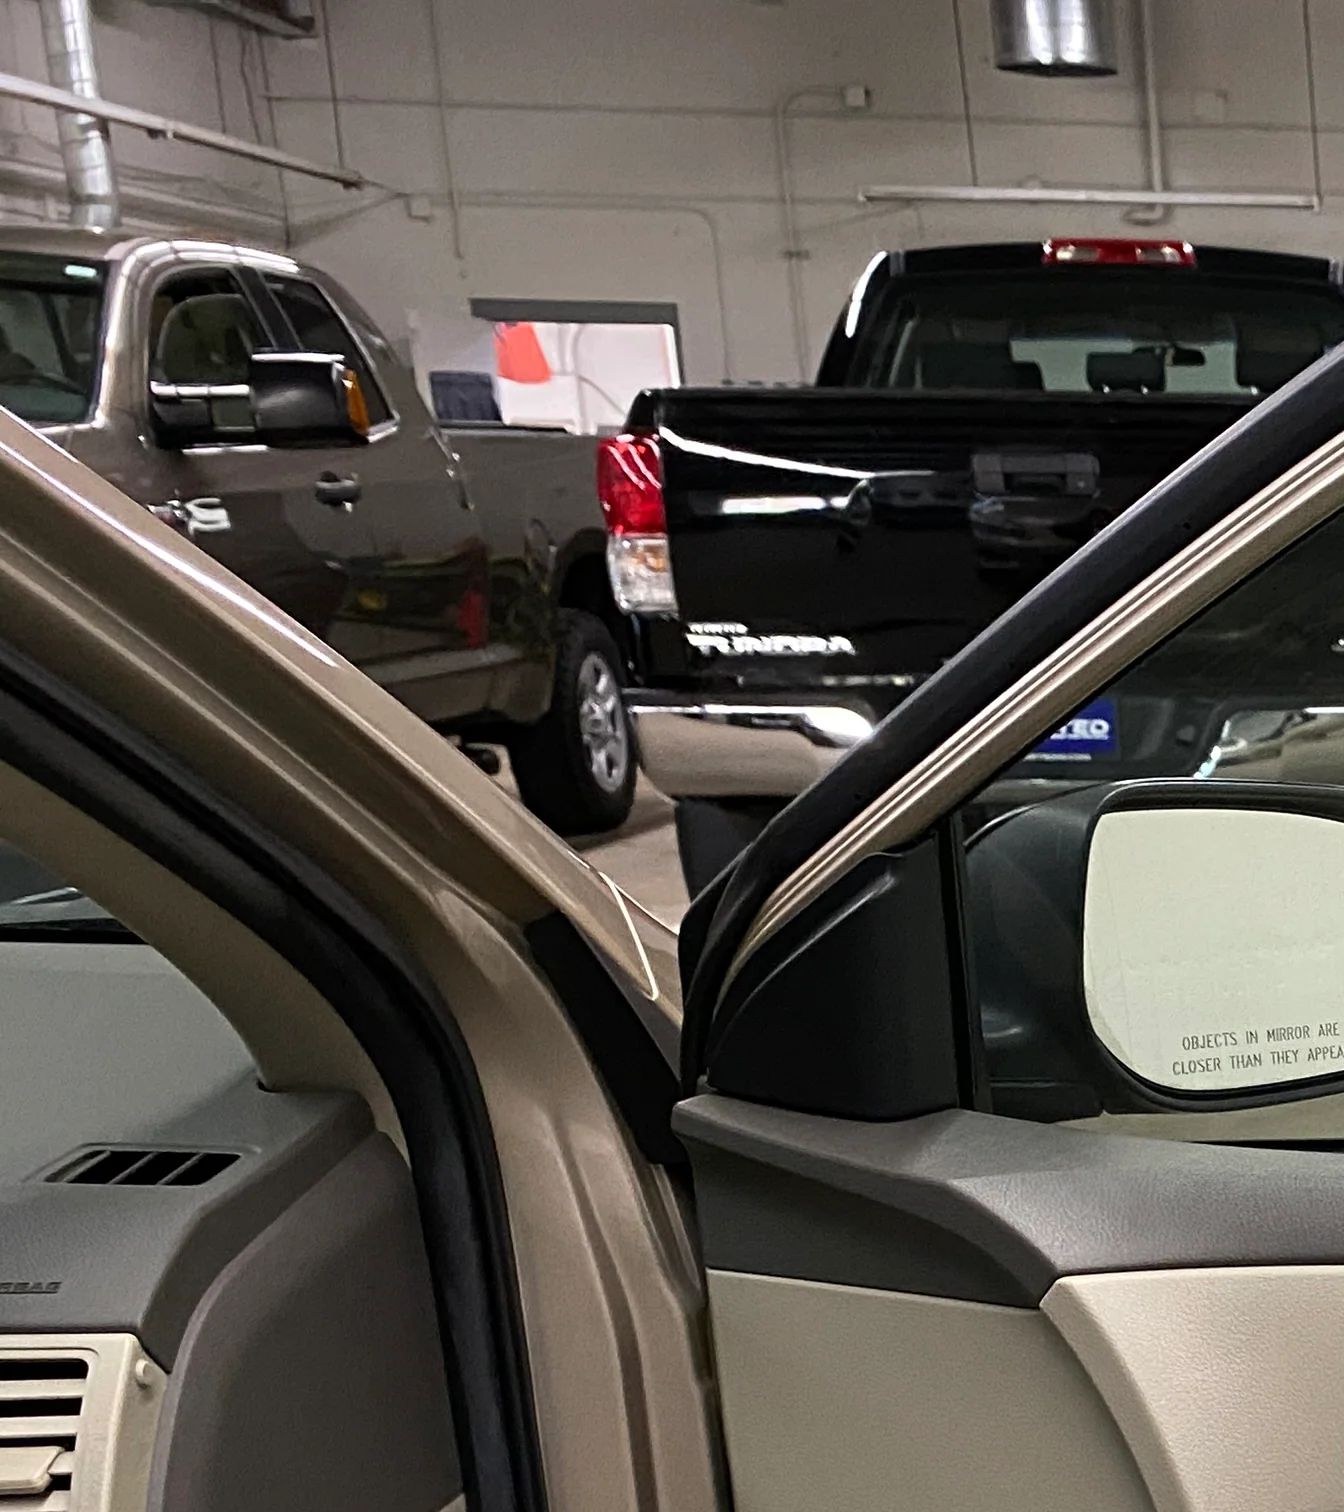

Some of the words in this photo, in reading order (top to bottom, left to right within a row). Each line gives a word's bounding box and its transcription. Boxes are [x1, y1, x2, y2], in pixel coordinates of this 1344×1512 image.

[1182, 1032, 1238, 1051] OBJECTS
[1245, 1030, 1259, 1045] IN
[1266, 1024, 1311, 1043] MIRROR
[1317, 1022, 1340, 1037] ARE
[1172, 1057, 1222, 1076] CLOSER
[1229, 1053, 1263, 1070] THAN
[1270, 1049, 1299, 1066] THEY
